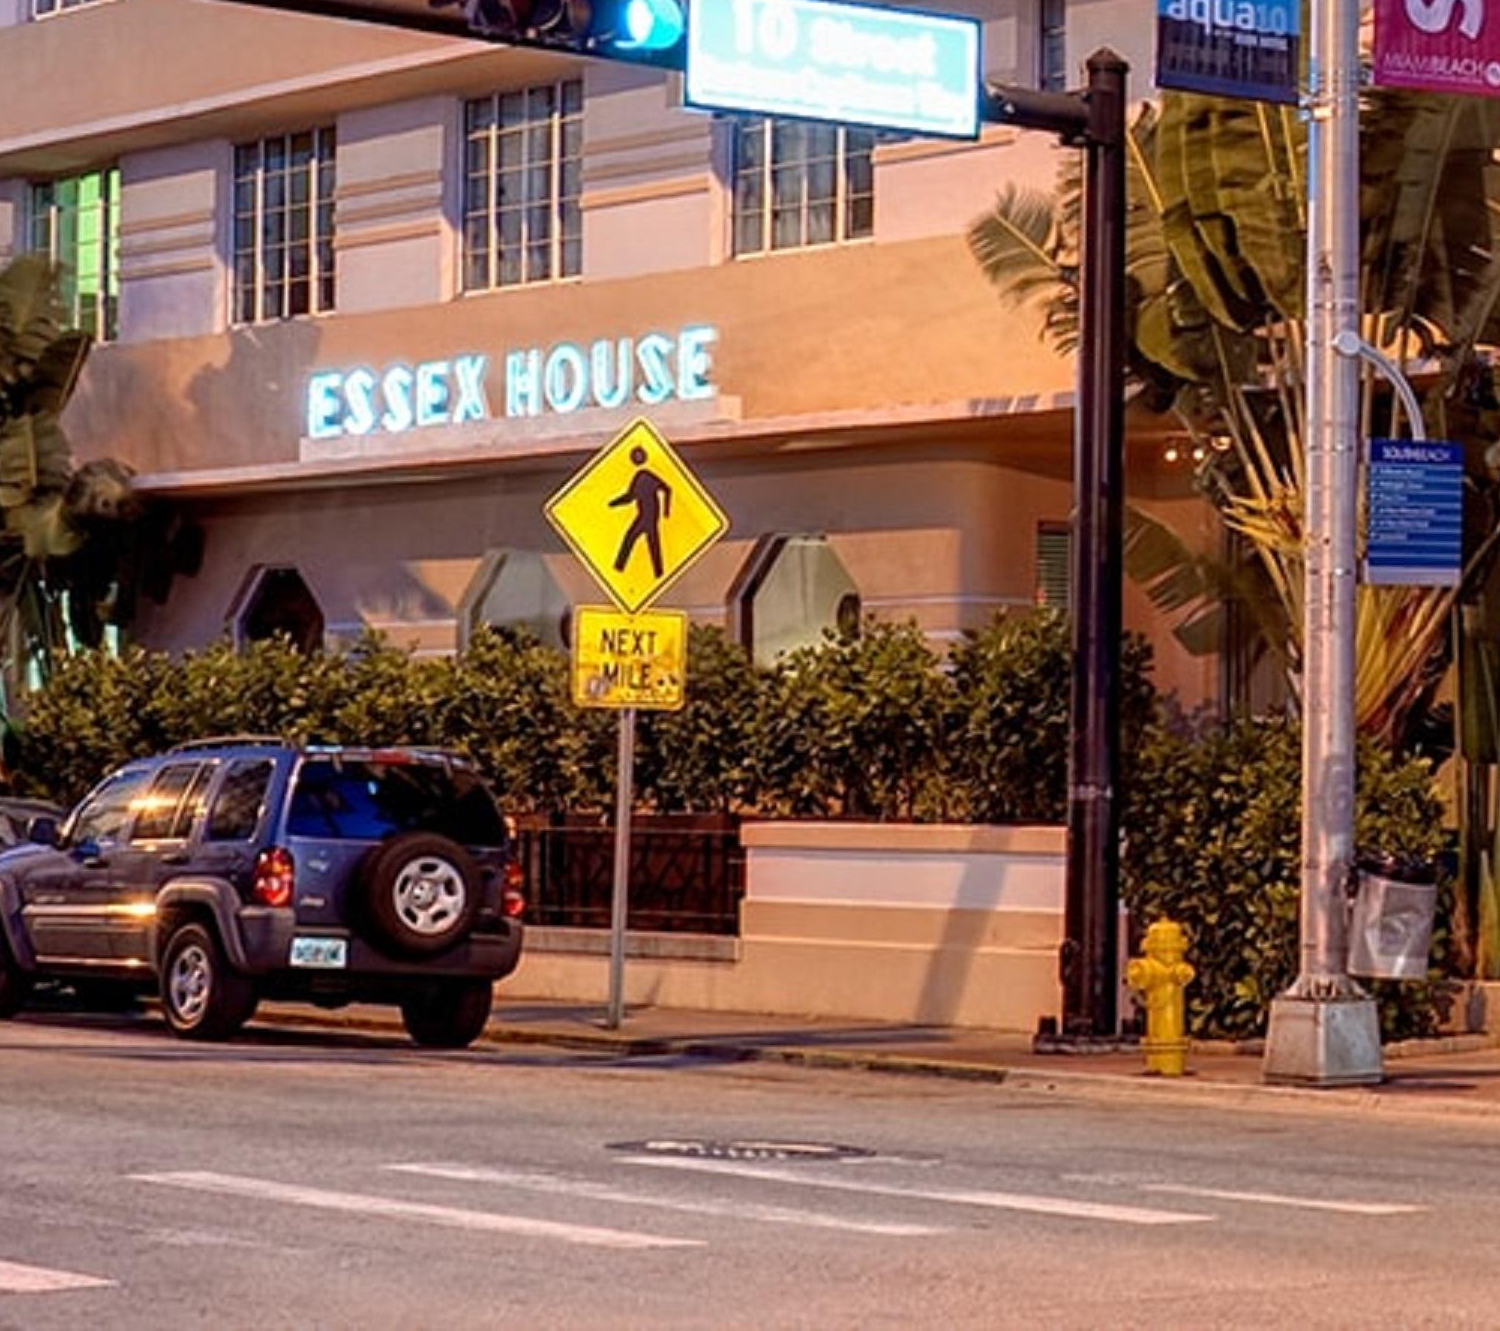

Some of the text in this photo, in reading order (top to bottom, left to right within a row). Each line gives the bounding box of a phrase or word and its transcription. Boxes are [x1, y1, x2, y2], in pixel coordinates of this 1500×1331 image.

[308, 326, 719, 438] ESSEX HOUSE
[601, 628, 658, 656] NEXT
[602, 663, 652, 690] MILE
